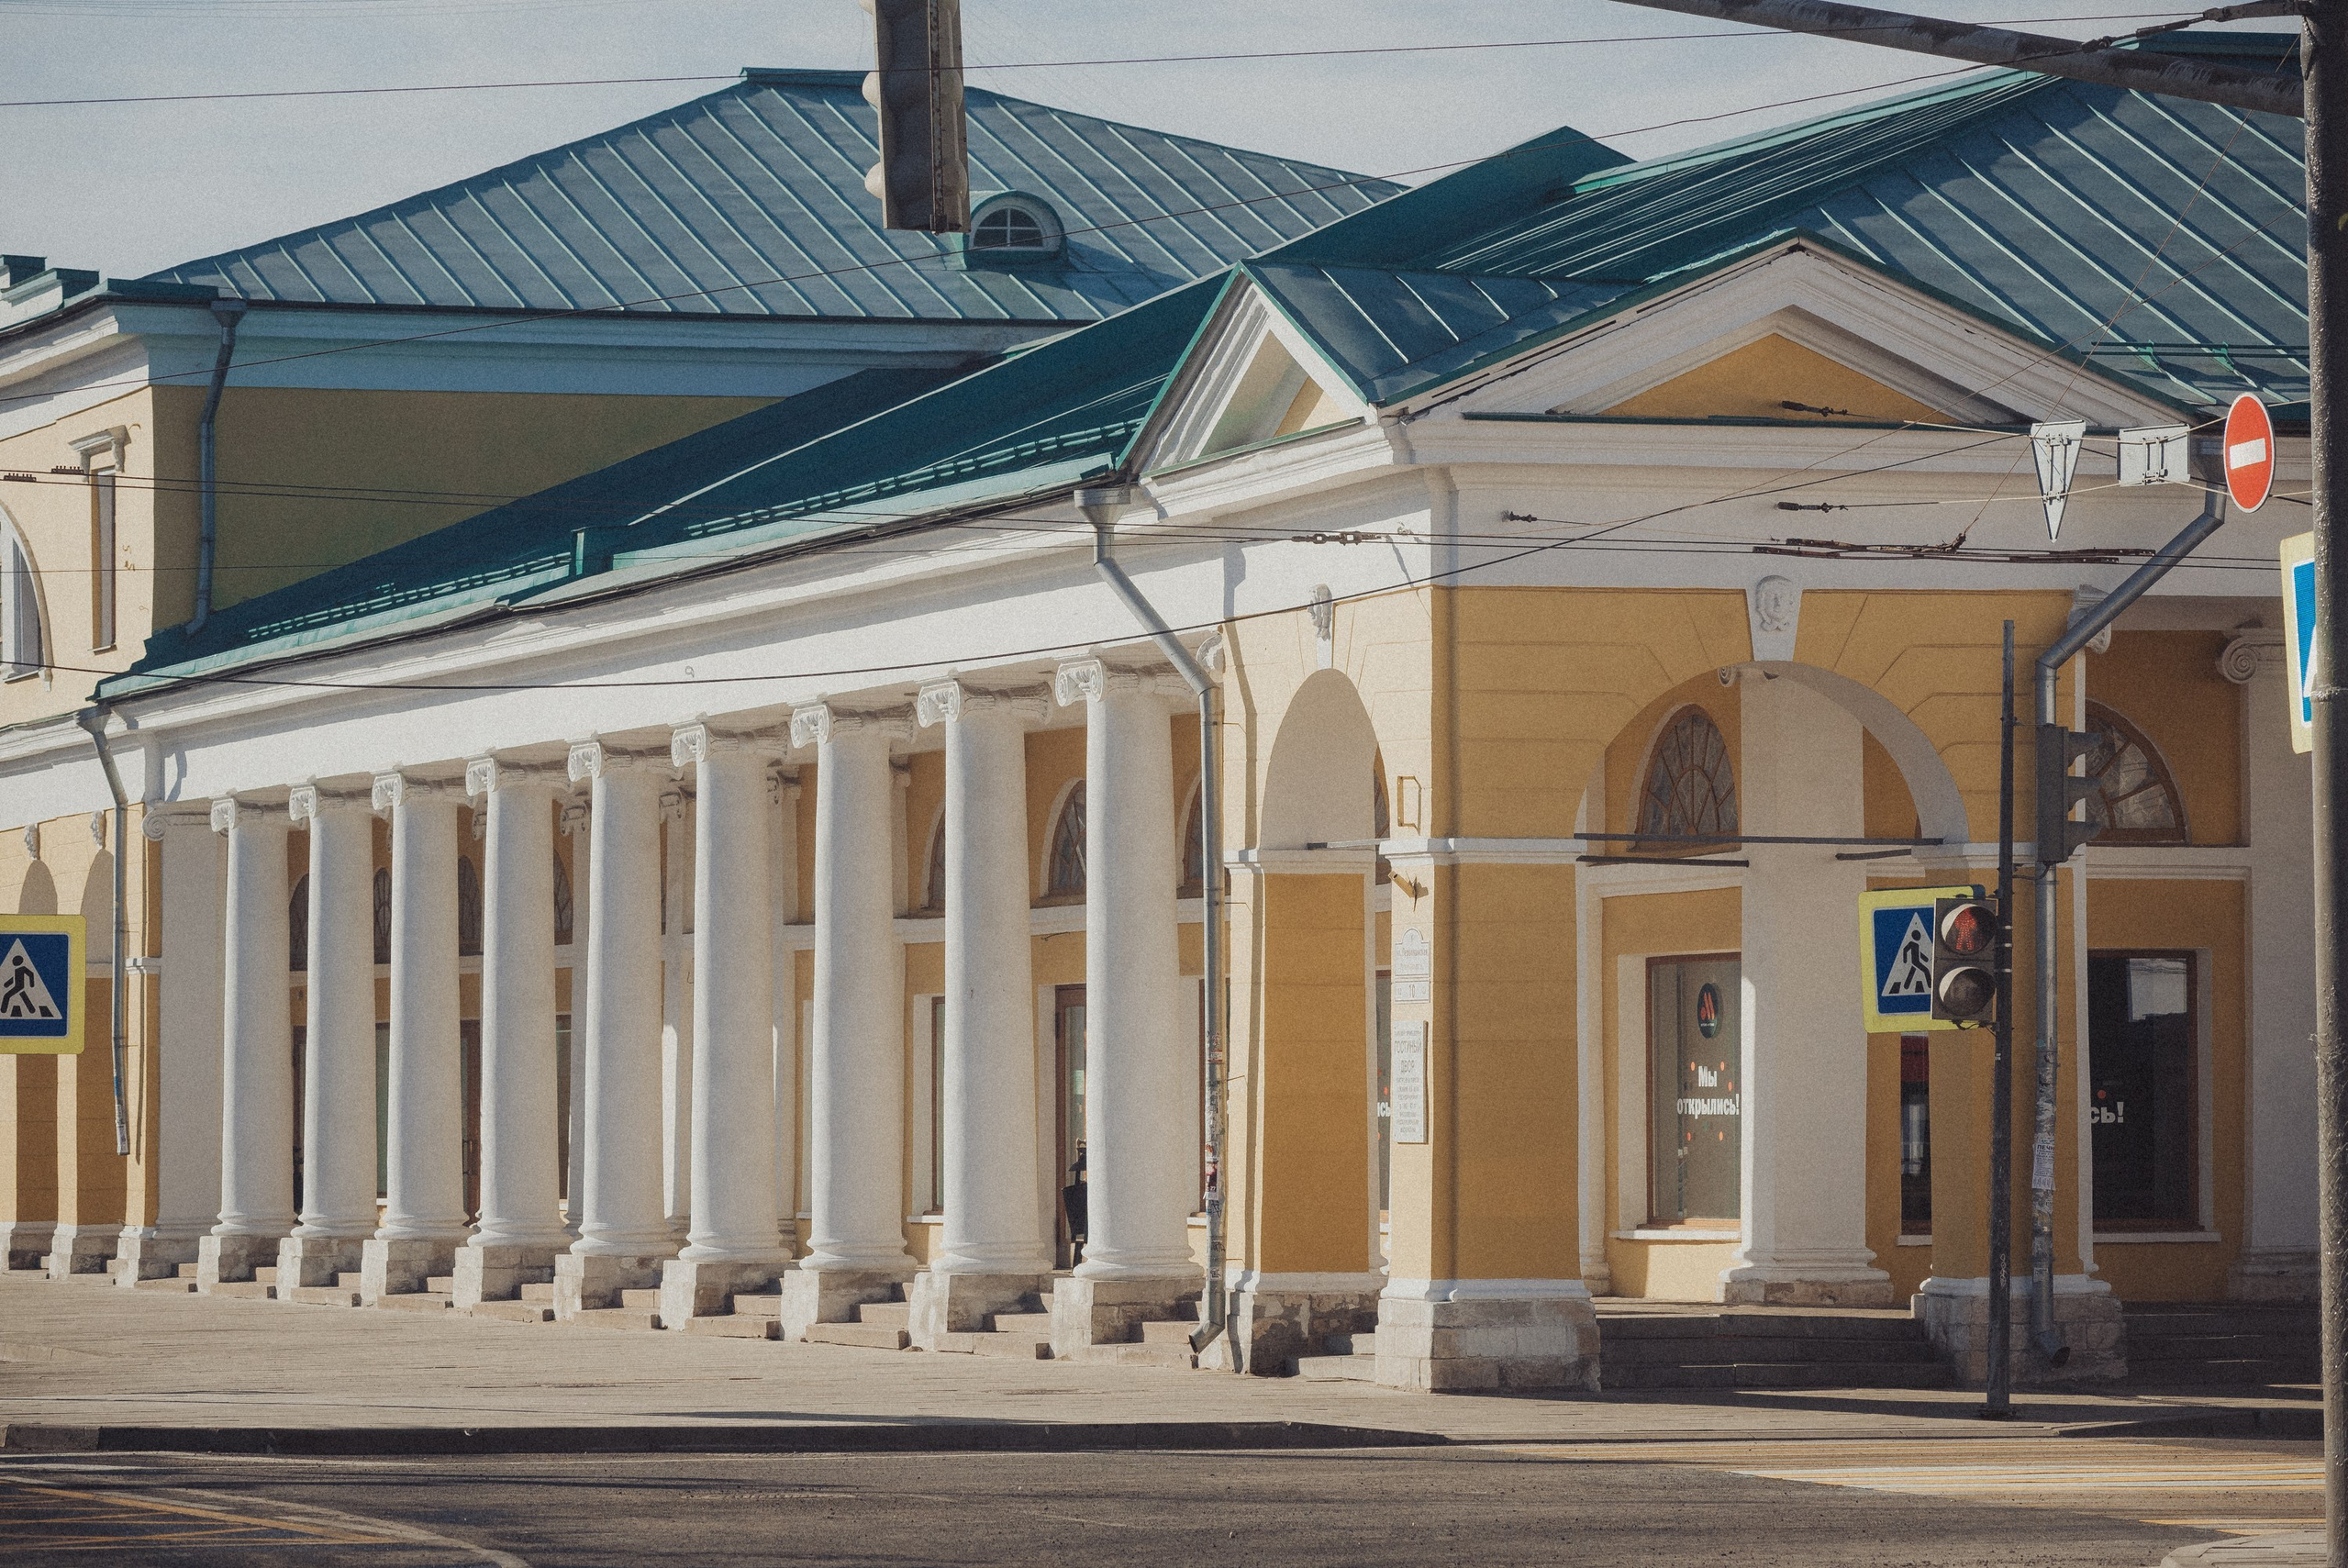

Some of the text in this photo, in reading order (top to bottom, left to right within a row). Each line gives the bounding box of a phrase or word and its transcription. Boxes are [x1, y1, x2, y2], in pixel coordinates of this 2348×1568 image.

[1408, 984, 1416, 998] 10
[1395, 1039, 1422, 1054] ГОСТИНЫЙ
[1400, 1059, 1415, 1073] ДВОР
[1698, 1065, 1718, 1087] Мы
[1676, 1093, 1740, 1119] открылись!
